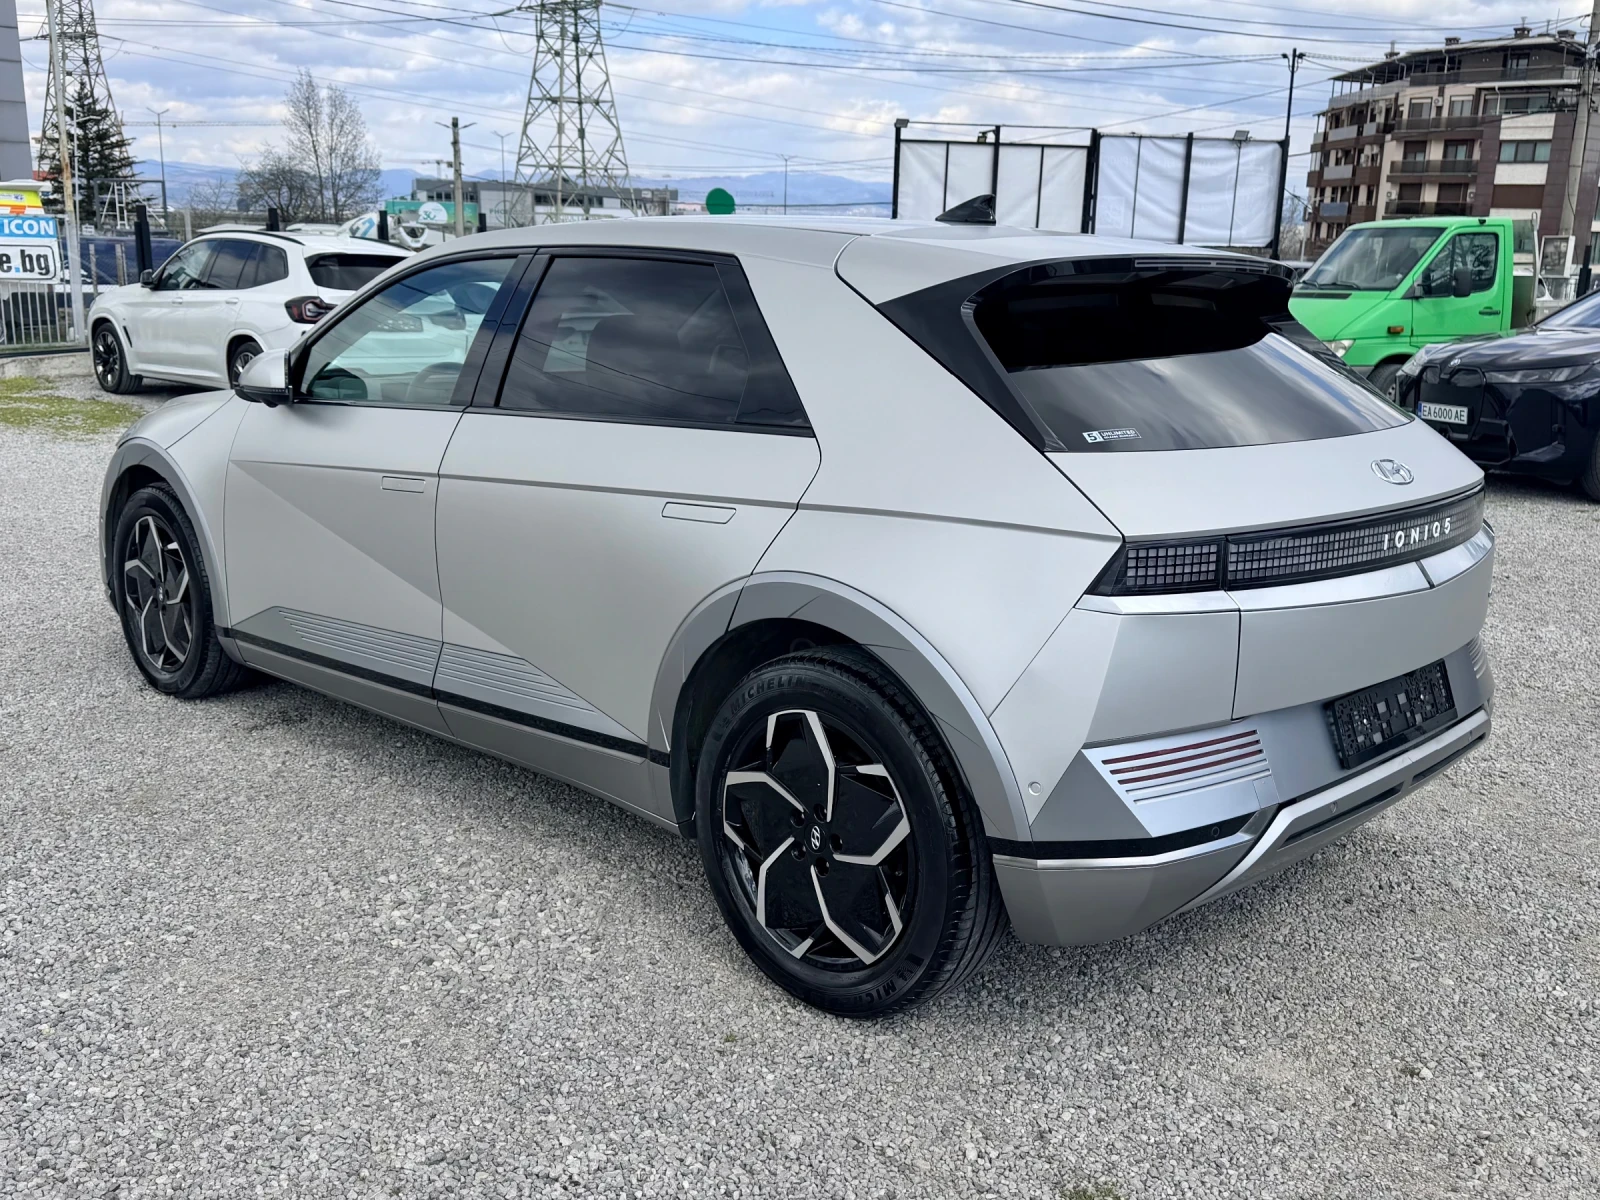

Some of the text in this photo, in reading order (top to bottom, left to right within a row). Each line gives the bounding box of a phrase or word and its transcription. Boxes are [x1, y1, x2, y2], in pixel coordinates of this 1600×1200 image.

[3, 218, 55, 236] ICON
[0, 249, 51, 276] e.bg
[1422, 405, 1466, 422] EA 6000 AE
[1087, 433, 1098, 441] 5
[1101, 429, 1136, 437] UNLIMITED
[1383, 517, 1451, 551] IONIQ 5
[730, 675, 807, 715] MICHELIN
